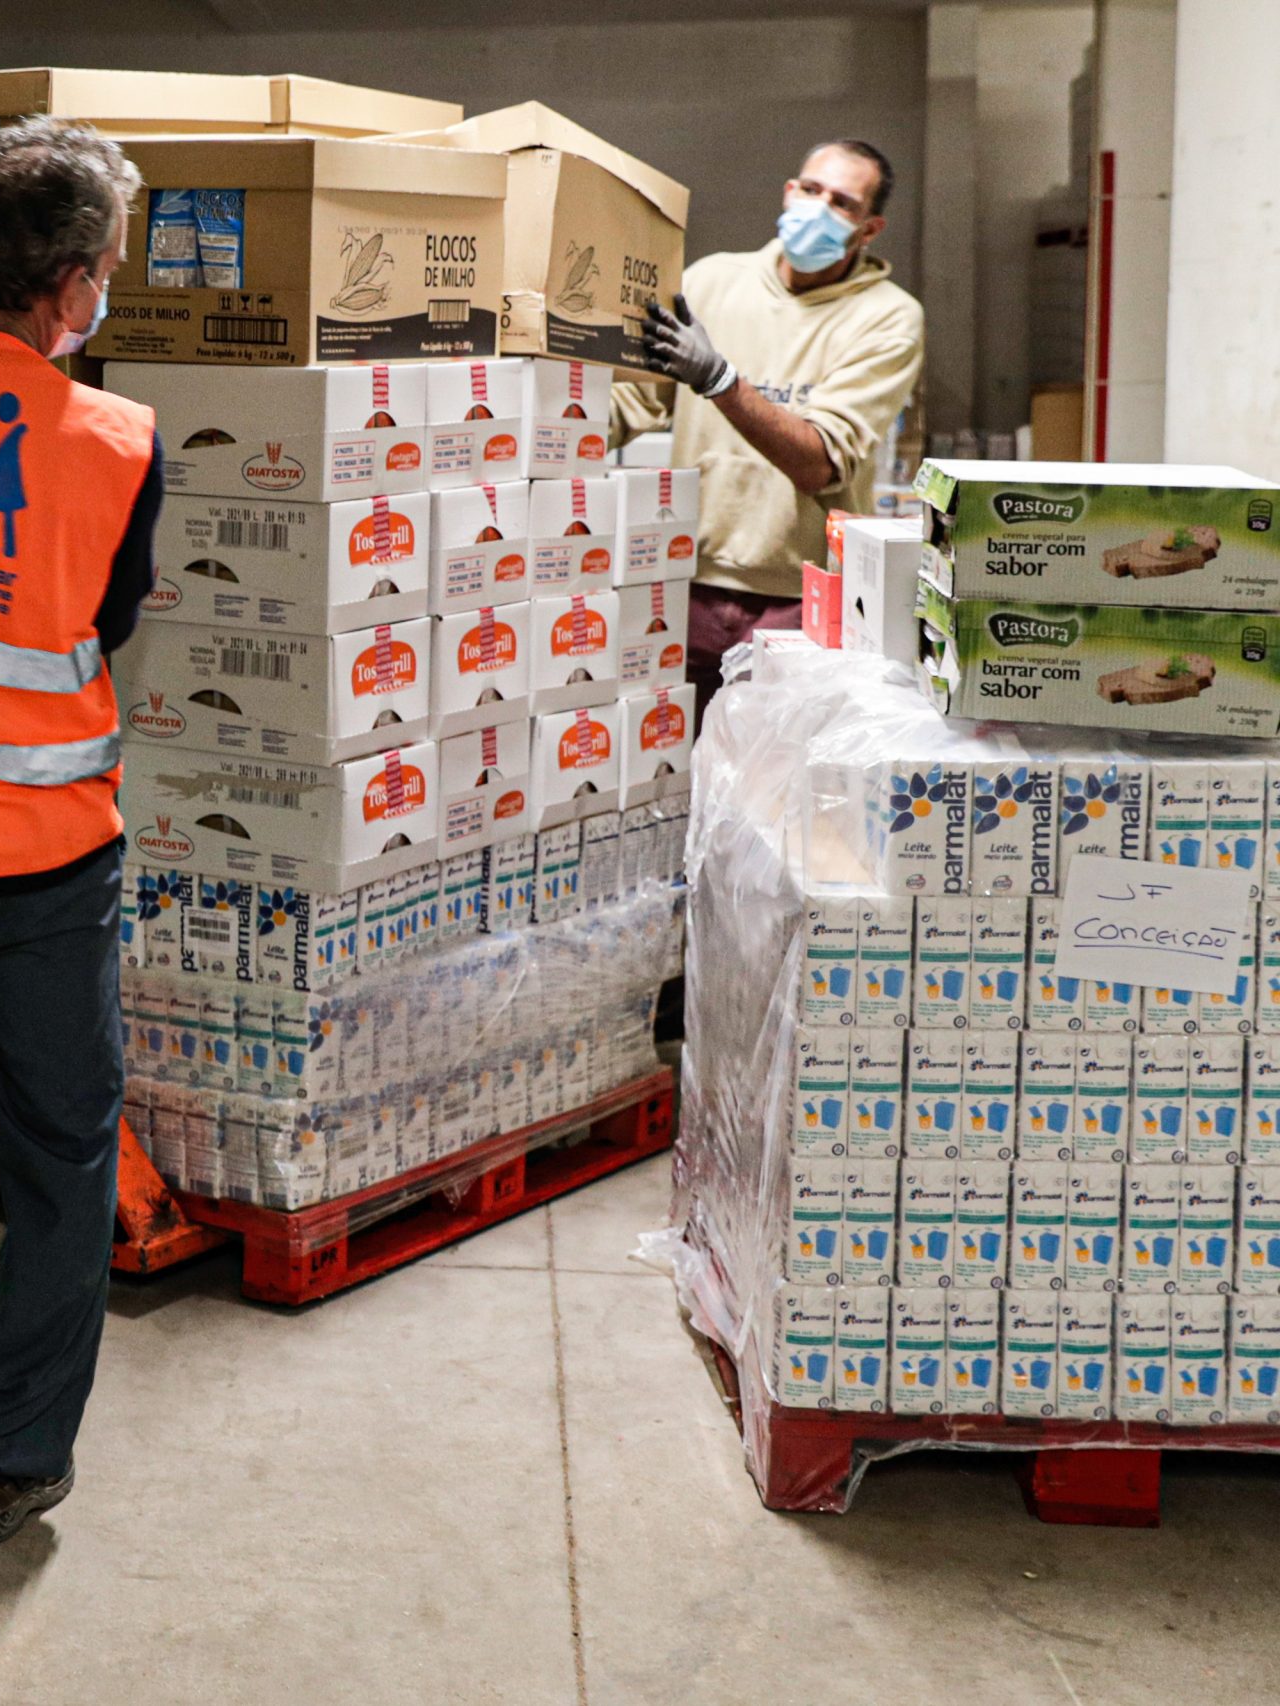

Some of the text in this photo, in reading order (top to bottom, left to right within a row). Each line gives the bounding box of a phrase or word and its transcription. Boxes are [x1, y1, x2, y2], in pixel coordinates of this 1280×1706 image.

[426, 235, 477, 262] FLOCOS
[425, 267, 476, 287] DE MILHO
[623, 256, 658, 288] FLOCOS
[621, 285, 631, 304] DE
[108, 307, 190, 321] OCOS DE MILHO
[246, 466, 301, 480] DIATOSTA
[1002, 499, 1074, 518] Pastora
[353, 525, 409, 552] Tosrill
[987, 537, 1085, 556] barrar com
[985, 555, 1048, 576] sabor
[555, 623, 603, 643] Tosrill
[997, 619, 1069, 642] Pastora
[461, 634, 512, 660] Tosrill
[356, 653, 411, 683] Tosrill
[982, 659, 1080, 681] barrar com
[980, 678, 1043, 699] sabor
[131, 713, 182, 728] DIATOSTA
[562, 731, 607, 750] Tosrill
[367, 776, 420, 808] Tosrill
[1117, 772, 1142, 860] rmalat
[943, 771, 967, 894] parmalat
[1029, 771, 1055, 895] parmalat
[139, 836, 190, 852] DIATOSTA
[904, 842, 932, 853] Leite
[990, 843, 1018, 853] Leite
[1078, 843, 1106, 854] Leite
[179, 875, 198, 972] palat
[236, 883, 253, 982] parmalat
[293, 892, 311, 993] parmalat
